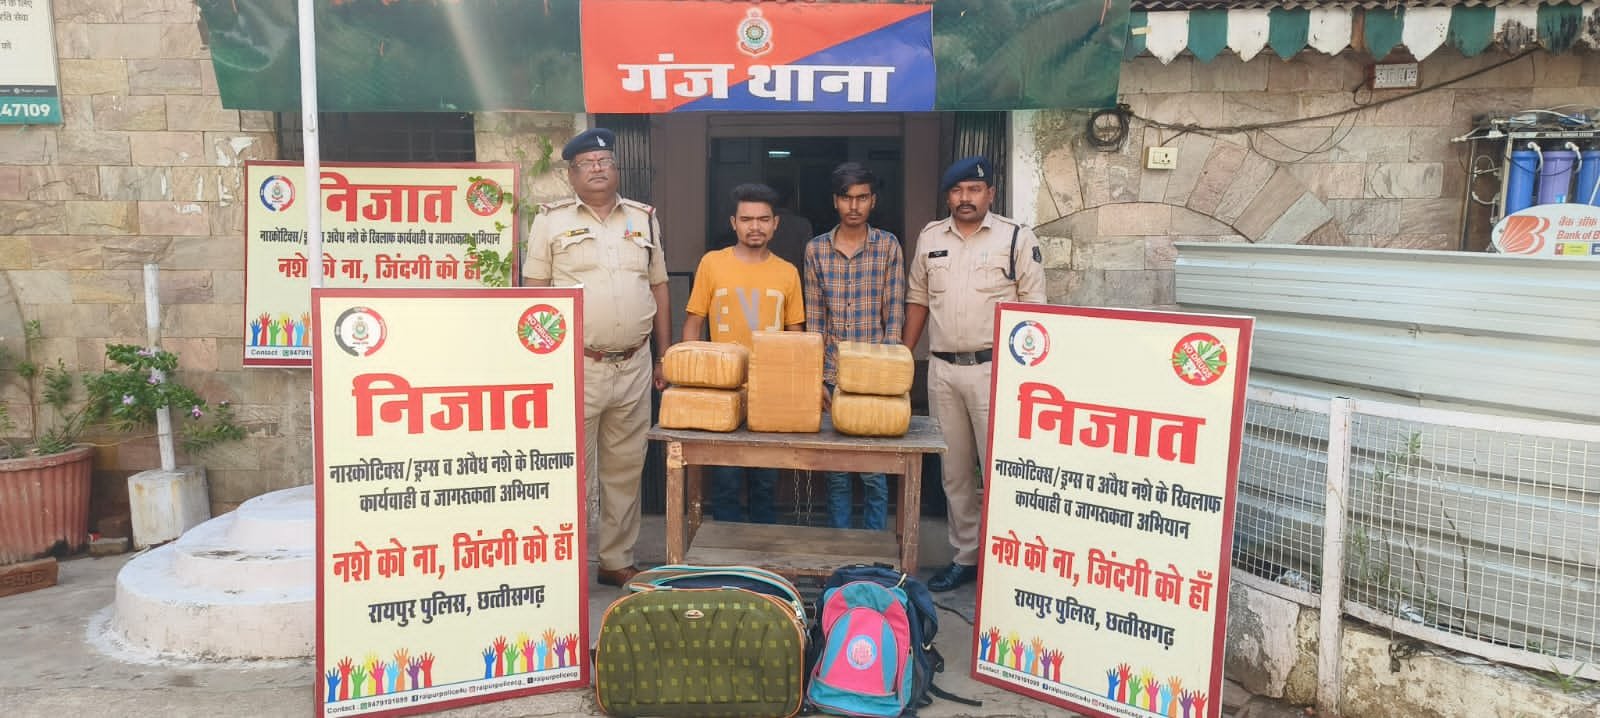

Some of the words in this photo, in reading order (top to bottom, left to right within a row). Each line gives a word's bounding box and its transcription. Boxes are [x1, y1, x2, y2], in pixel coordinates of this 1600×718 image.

[617, 53, 735, 100] गंज
[747, 64, 895, 104] थाना
[277, 252, 308, 278] नशे
[341, 259, 369, 284] ना,
[375, 253, 433, 280] जिंदगी
[435, 253, 460, 280] को
[352, 373, 554, 437] निजात
[1017, 381, 1206, 465] निजात
[442, 458, 453, 476] व
[456, 450, 489, 475] अवैध
[490, 449, 513, 473] नशे
[514, 449, 527, 472] के
[529, 448, 575, 472] खिलाफ
[359, 486, 418, 513] कार्यवाही
[419, 489, 431, 508] व
[499, 479, 550, 502] अभियान
[1015, 488, 1062, 514] कार्यवाही
[1063, 499, 1073, 517] व
[1136, 510, 1191, 539] अभियान
[1086, 473, 1096, 492] व
[1097, 472, 1129, 498] अवैध
[1131, 477, 1154, 502] नशे
[1155, 480, 1169, 504] के
[1171, 483, 1223, 514] खिलाफ
[332, 540, 373, 583] नशे
[376, 537, 407, 579] को
[412, 543, 446, 580] ना,
[452, 528, 518, 571] जिंदगी
[521, 524, 548, 564] को
[553, 522, 575, 561] हाँ
[991, 529, 1022, 568] नशे
[1024, 535, 1049, 574] को
[1052, 546, 1081, 588] ना,
[1087, 548, 1152, 598] जिंदगी
[1154, 563, 1183, 606] को
[1188, 568, 1214, 612] हाँ
[367, 598, 417, 628] रायपुर
[420, 591, 472, 625] पुलिस,
[477, 583, 546, 610] छत्तीसगढ़
[1014, 587, 1052, 619] रायपुर
[1055, 596, 1101, 632] पुलिस,
[1105, 609, 1176, 650] छत्तीसगढ़
